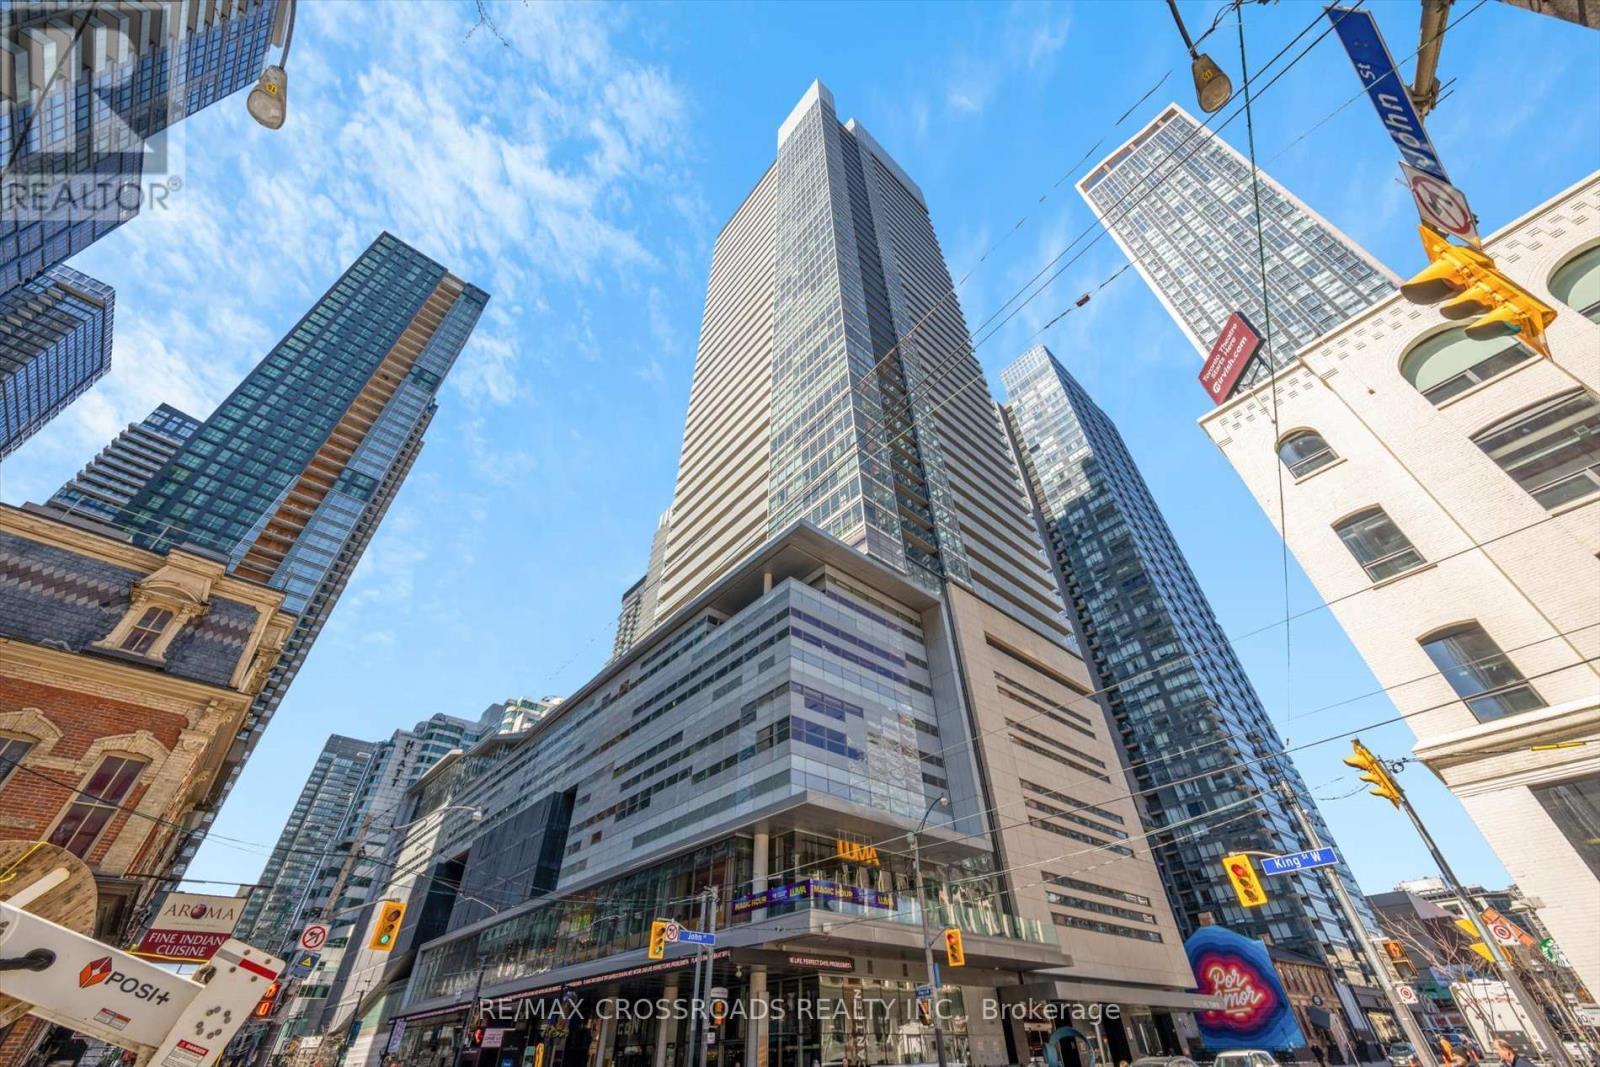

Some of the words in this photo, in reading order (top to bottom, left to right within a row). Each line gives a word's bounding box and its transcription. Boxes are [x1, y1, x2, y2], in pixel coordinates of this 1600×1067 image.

[1358, 63, 1376, 80] St
[1378, 93, 1434, 168] John
[1203, 354, 1221, 382] Toronto
[1219, 323, 1238, 354] Theatre
[1211, 356, 1226, 380] Starts
[1224, 336, 1237, 357] Here
[836, 839, 881, 867] LUMA
[1273, 856, 1302, 869] King
[1311, 850, 1321, 862] W
[813, 885, 834, 896] MAGIC
[835, 887, 853, 898] HOUR
[149, 932, 178, 943] FINE
[179, 934, 225, 946] INDIAN
[687, 932, 702, 941] John
[156, 944, 207, 957] CUISINE
[1208, 966, 1248, 990] Por
